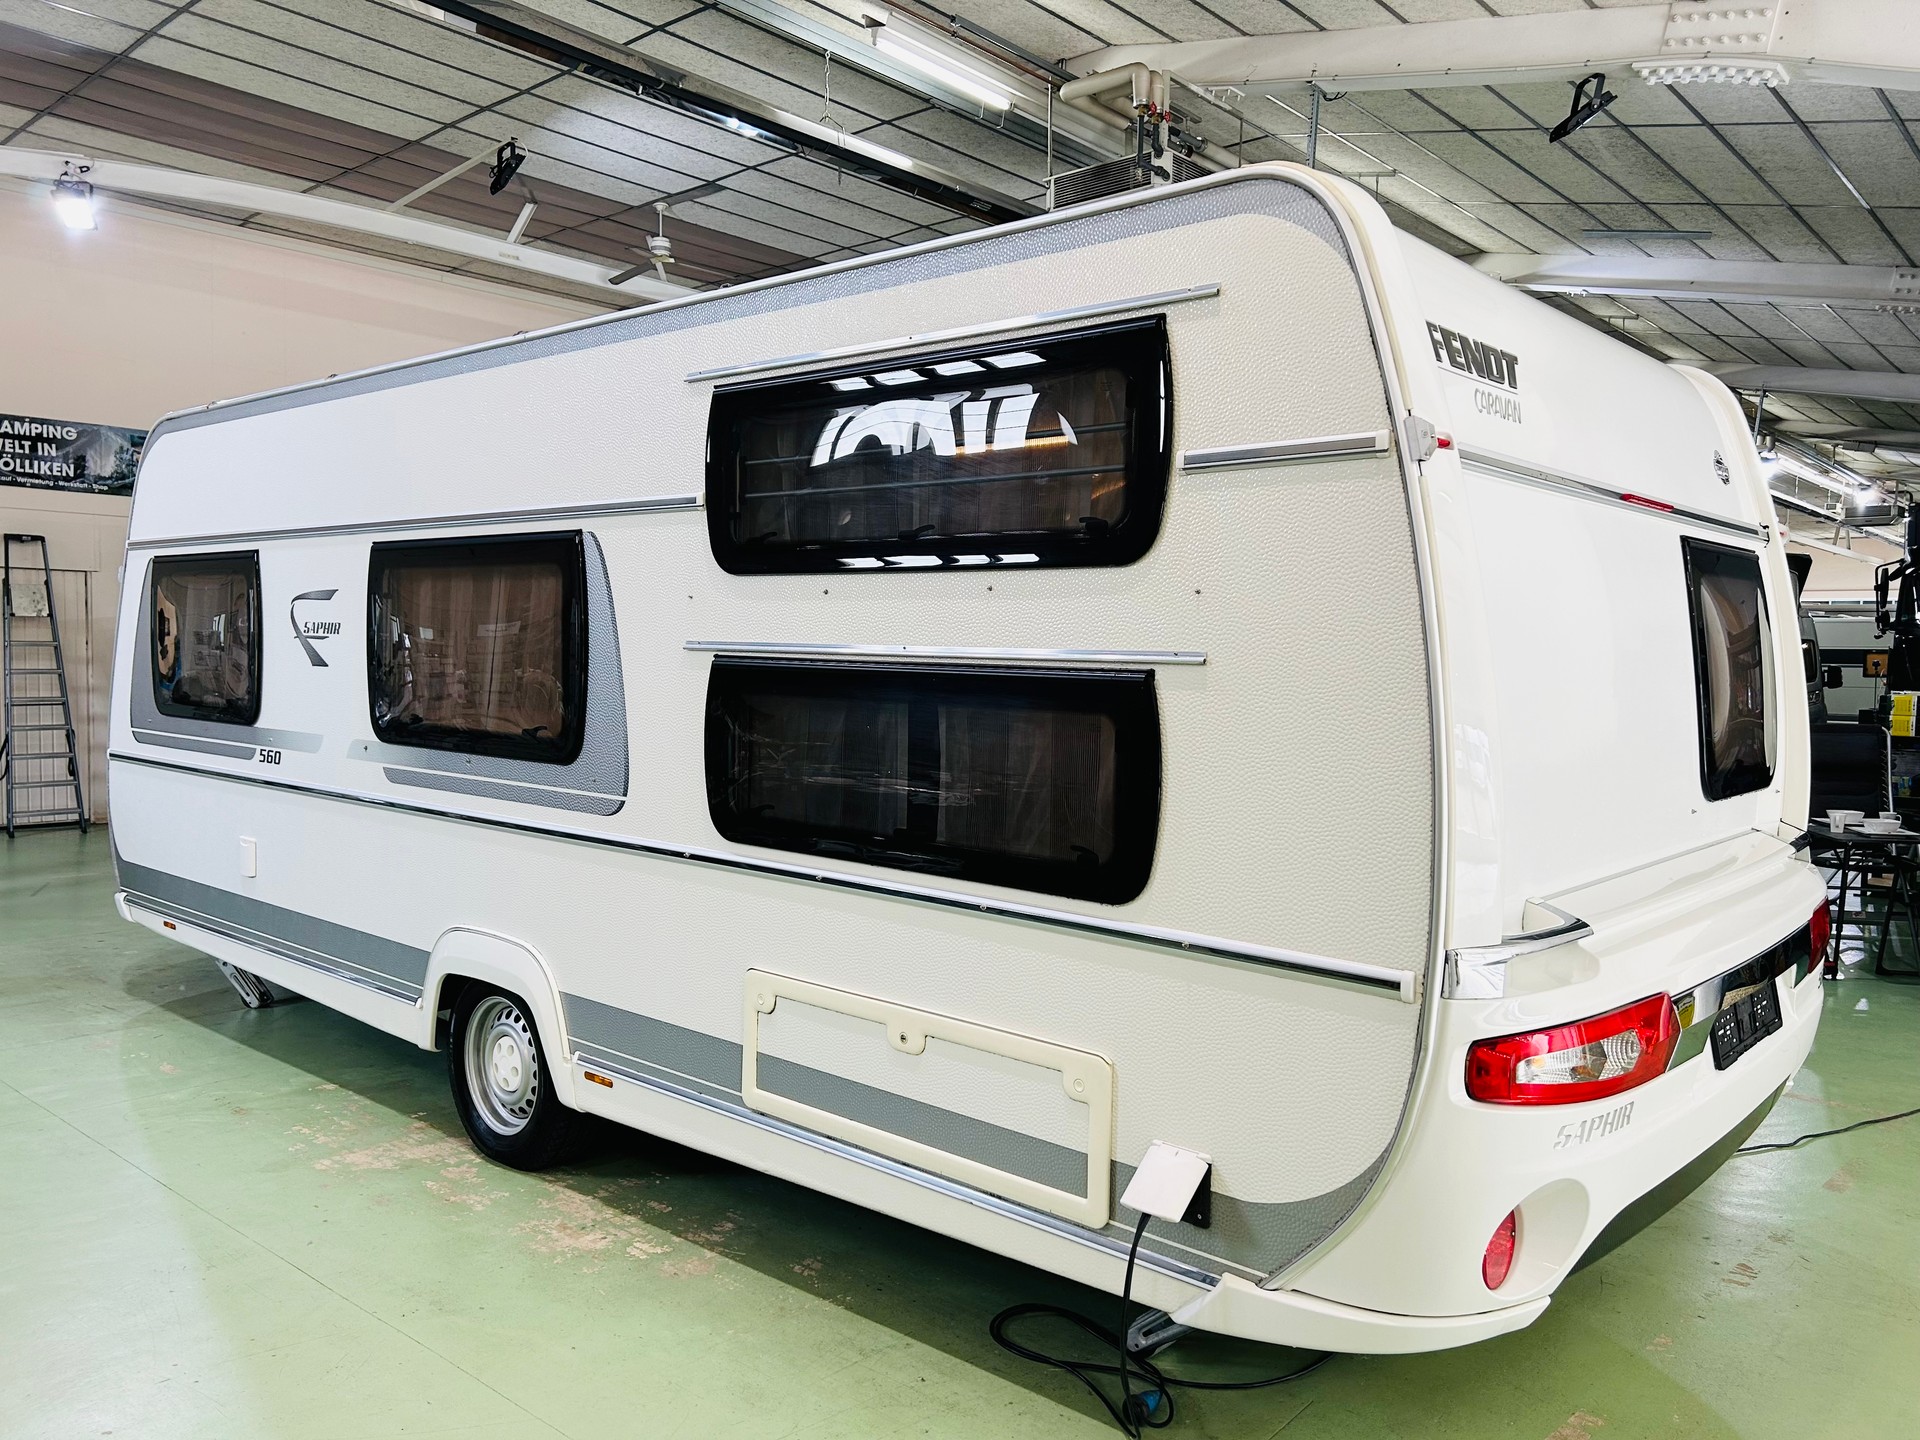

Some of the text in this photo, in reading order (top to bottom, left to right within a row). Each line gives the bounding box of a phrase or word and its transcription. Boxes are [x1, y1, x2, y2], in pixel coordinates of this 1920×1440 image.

[1425, 319, 1519, 389] FENDT
[1474, 387, 1522, 424] CARAVAN
[37, 442, 57, 457] IN
[16, 476, 54, 487] Vermietung
[58, 480, 88, 489] Werkstatt
[92, 483, 109, 491] Shop
[303, 621, 341, 635] SAPHIR
[258, 748, 282, 765] 560
[1553, 1100, 1635, 1150] SAPHIR
